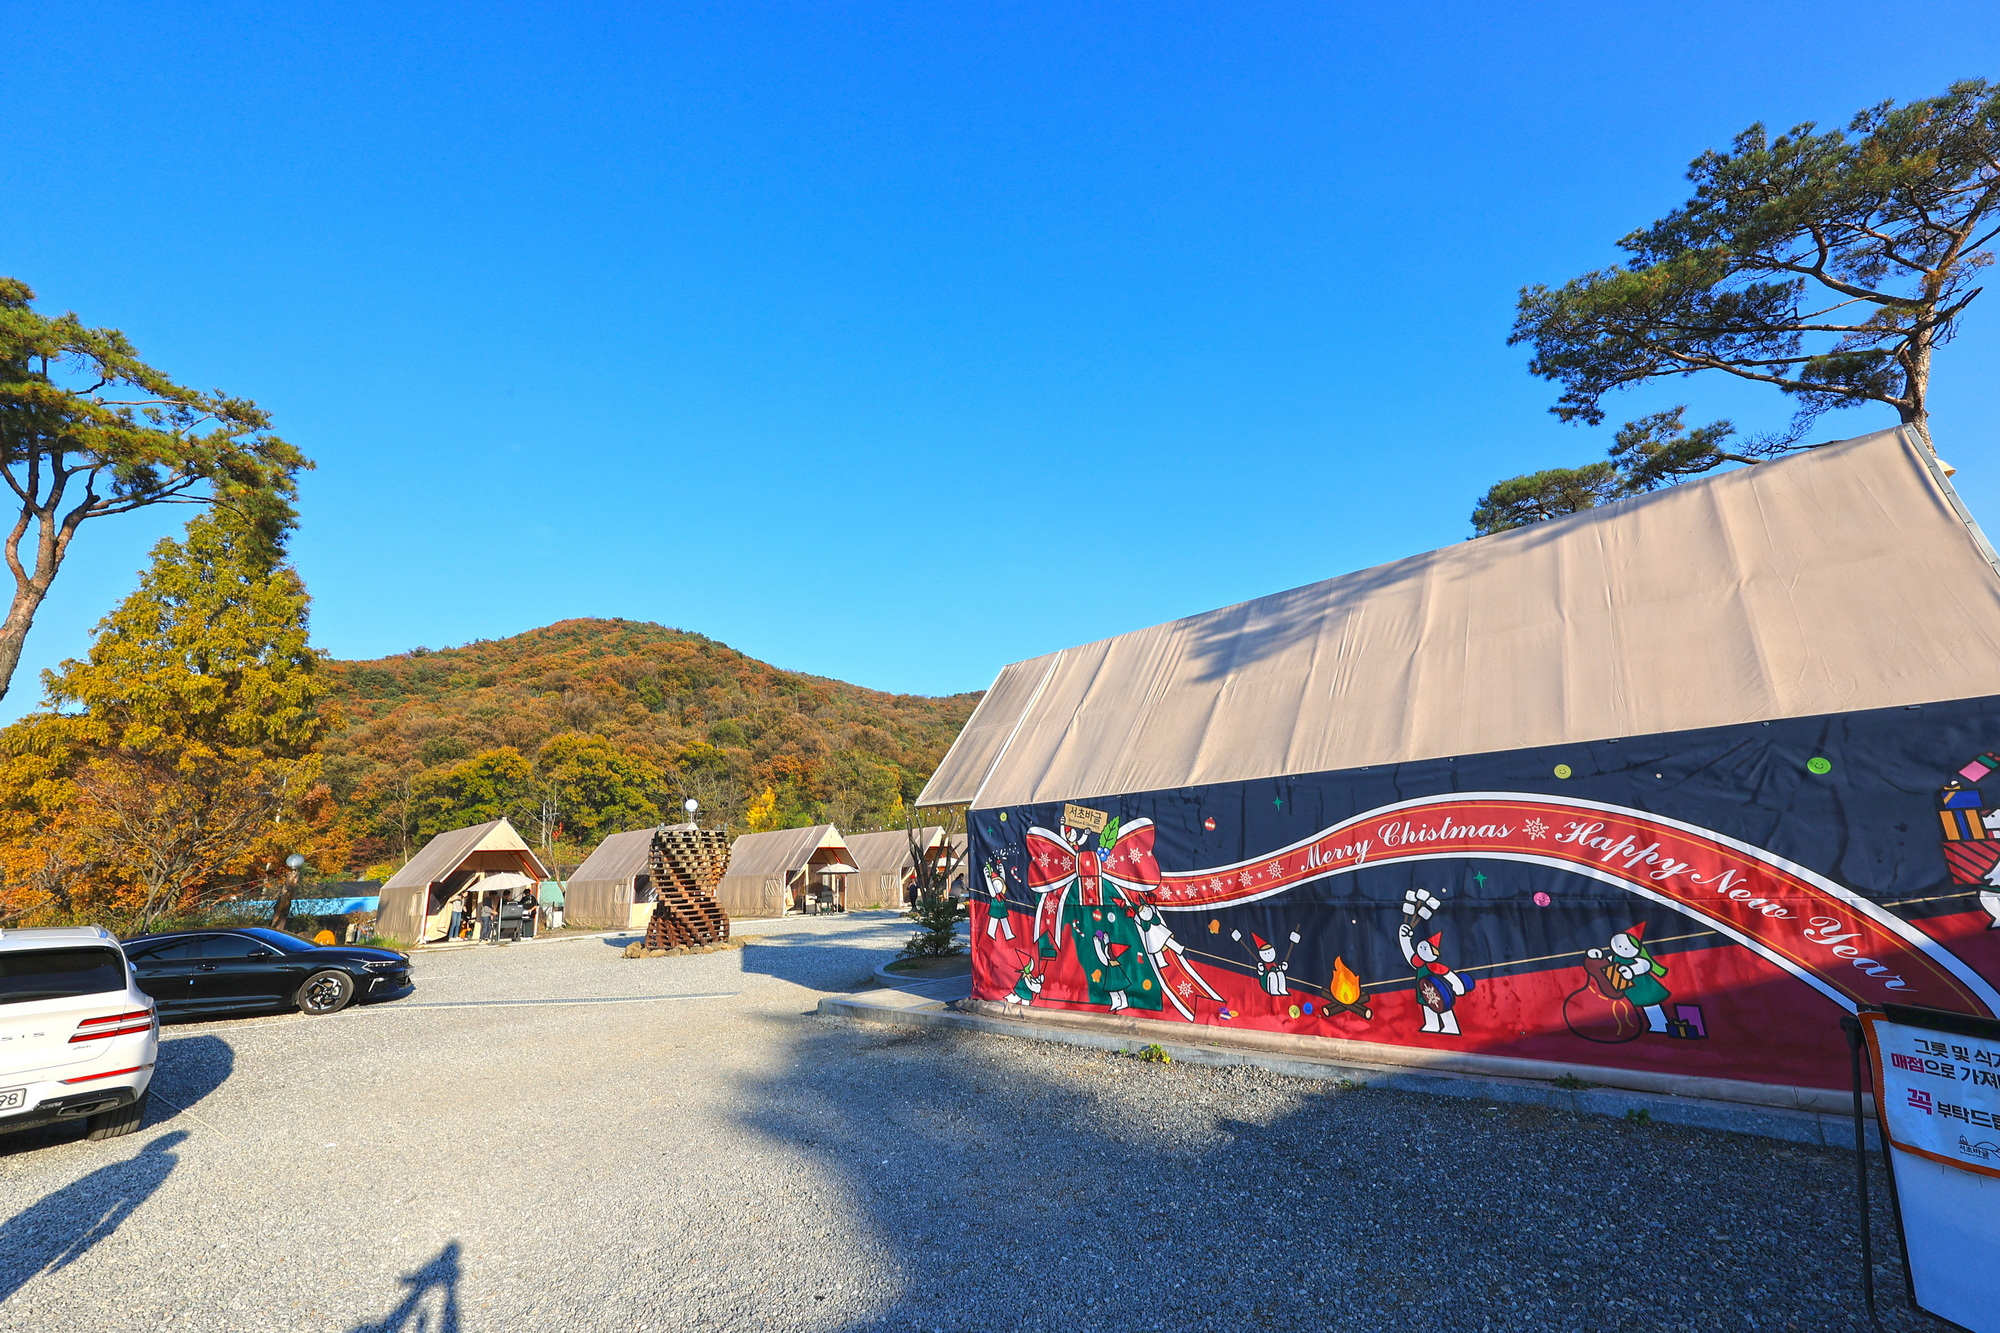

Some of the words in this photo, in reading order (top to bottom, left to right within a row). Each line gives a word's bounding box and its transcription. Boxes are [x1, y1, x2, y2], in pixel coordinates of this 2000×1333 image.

[1070, 806, 1103, 825] 서초바글
[1300, 839, 1374, 872] Merry
[1377, 816, 1517, 847] Chistmas
[1555, 821, 1697, 880] Happy
[1690, 869, 1798, 920] New
[1803, 916, 1918, 992] Year
[1913, 1038, 1949, 1059] 그릇
[1951, 1045, 1971, 1063] 및
[1890, 1052, 1956, 1080] 매점으로
[1960, 1066, 2000, 1090] 가져
[1907, 1087, 1933, 1116] 꼭
